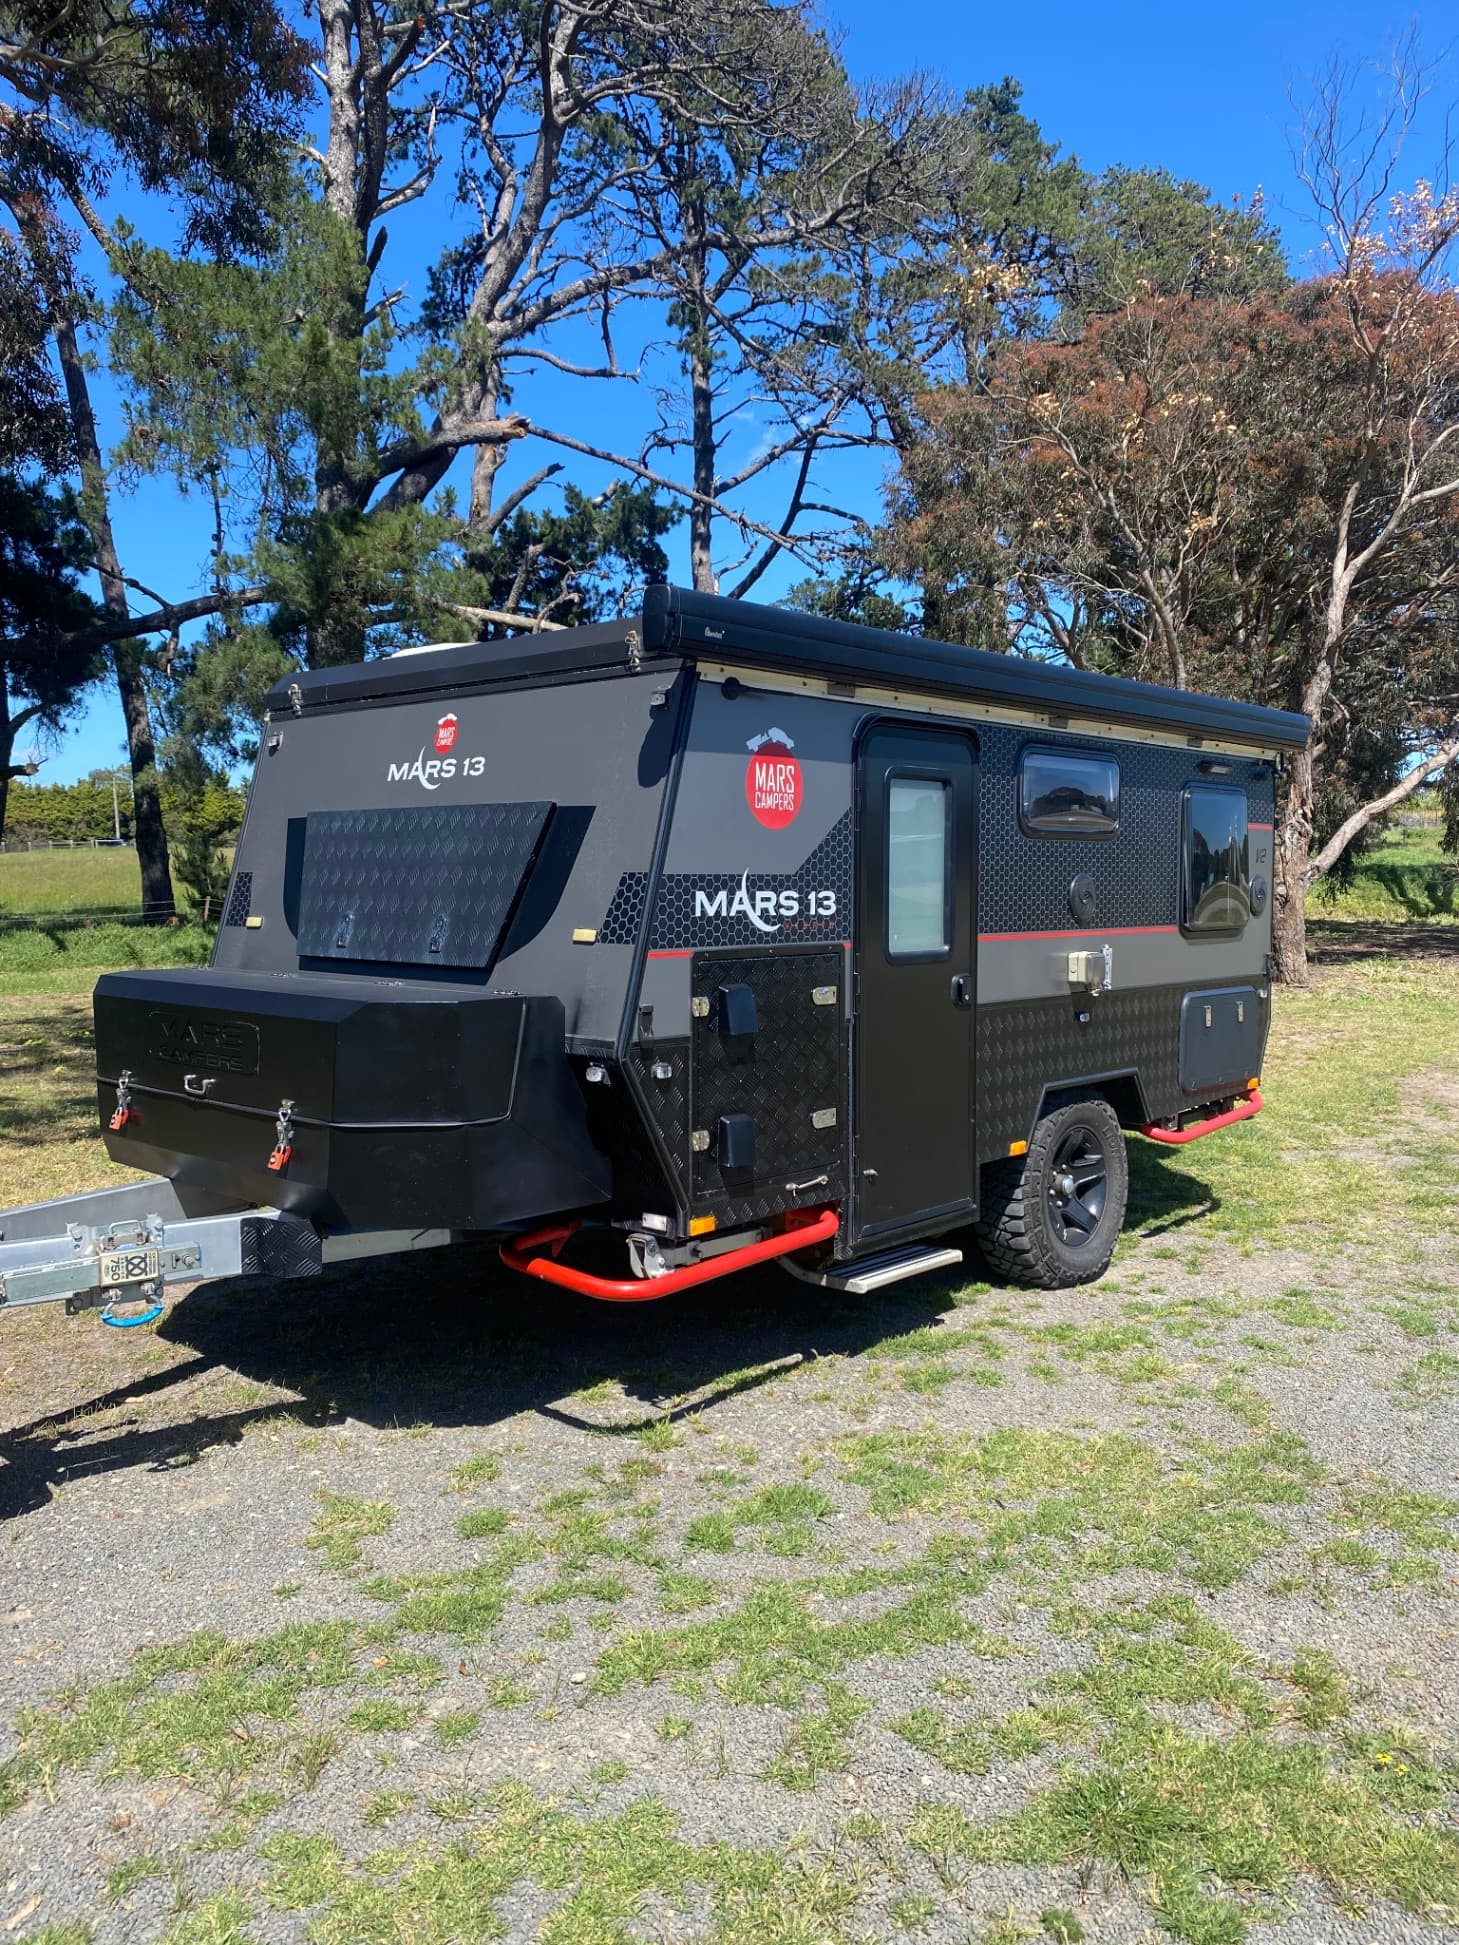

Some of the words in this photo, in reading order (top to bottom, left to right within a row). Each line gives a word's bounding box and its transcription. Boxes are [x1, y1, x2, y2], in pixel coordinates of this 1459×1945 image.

[463, 756, 486, 776] 13
[755, 762, 795, 793] MARS
[755, 791, 795, 811] CAMPERS
[807, 890, 837, 916] 13
[111, 1257, 121, 1281] 750
